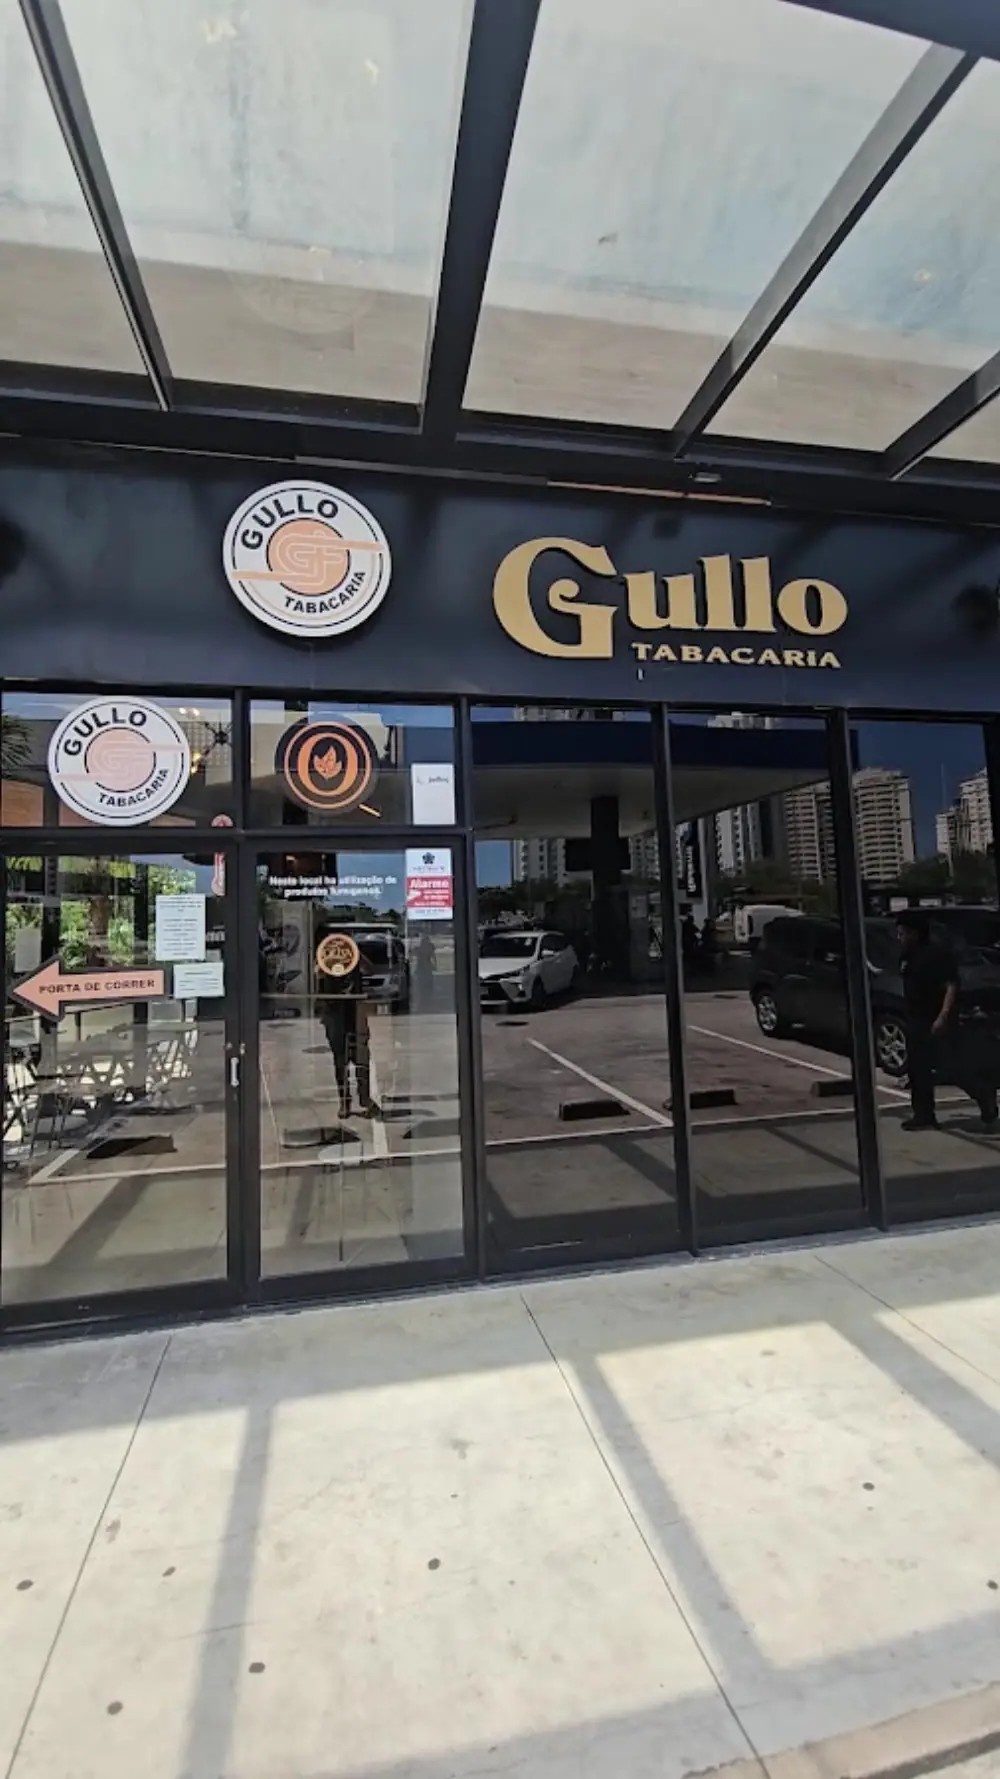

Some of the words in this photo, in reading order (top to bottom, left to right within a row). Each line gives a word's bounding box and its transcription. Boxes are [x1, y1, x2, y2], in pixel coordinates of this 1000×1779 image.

[241, 495, 339, 550] GULLO
[284, 570, 366, 614] TABACARIA
[493, 536, 848, 658] Gullo
[631, 642, 841, 668] TABACARIA
[63, 707, 147, 756] GULLO
[98, 768, 169, 808] TABACARIA
[268, 876, 297, 887] Neste
[300, 876, 323, 886] local
[339, 875, 383, 887] utilização
[384, 876, 398, 885] de
[284, 886, 329, 899] produtos
[410, 878, 450, 889] Alarme
[38, 983, 82, 994] PORTA
[84, 981, 101, 992] DE
[104, 979, 156, 991] CORRER
